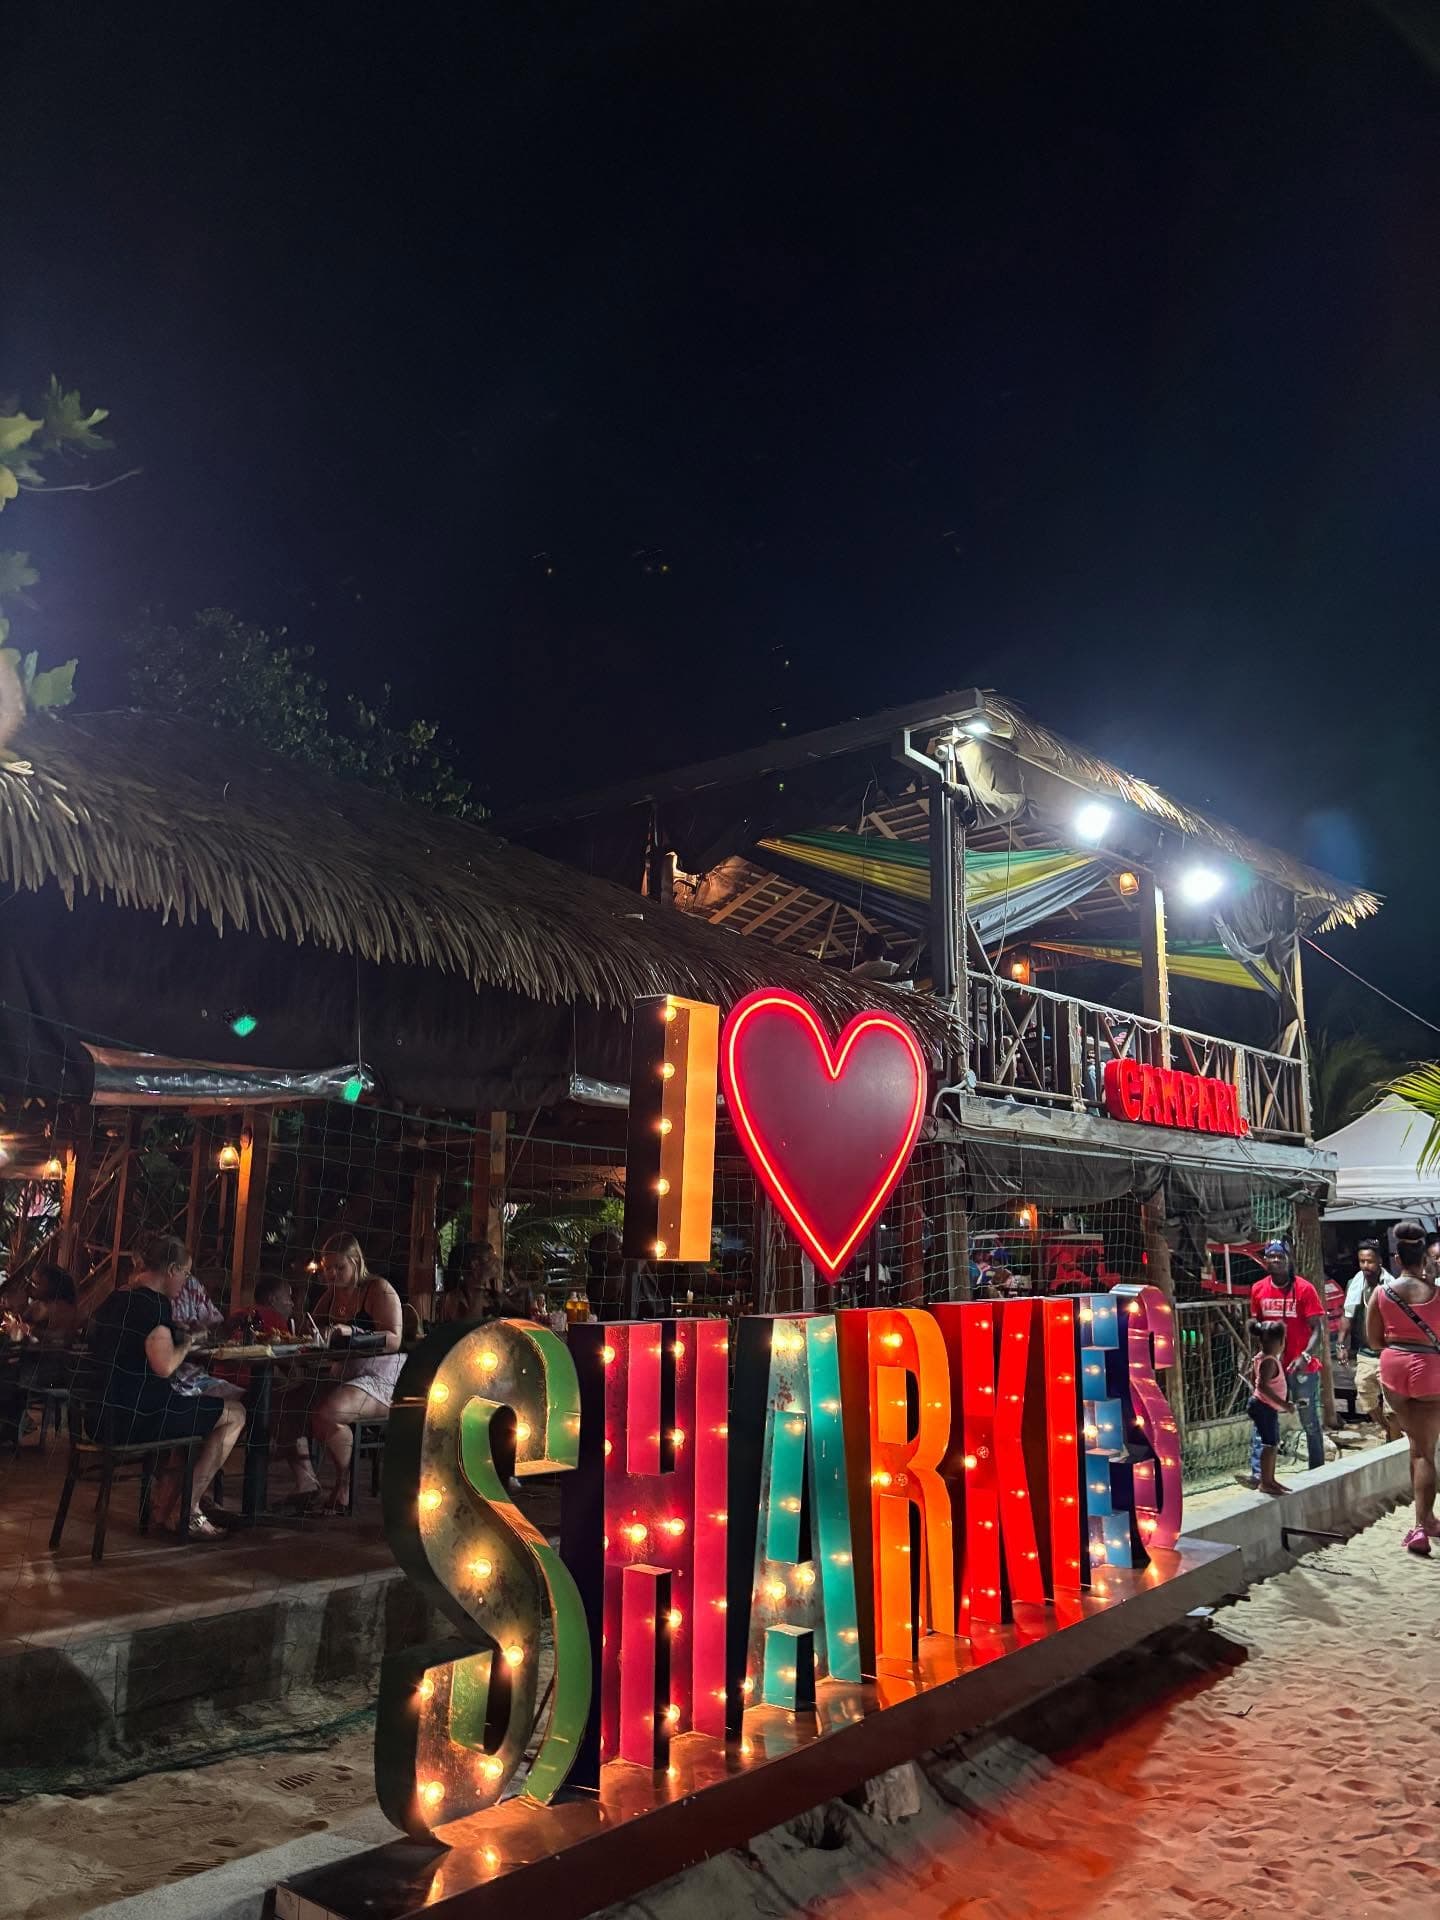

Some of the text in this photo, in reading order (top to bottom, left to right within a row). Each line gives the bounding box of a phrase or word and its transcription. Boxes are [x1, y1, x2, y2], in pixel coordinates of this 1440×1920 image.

[626, 994, 719, 1262] I
[1104, 1058, 1243, 1137] CAMPARI
[376, 1285, 1183, 1845] SHARKIES
